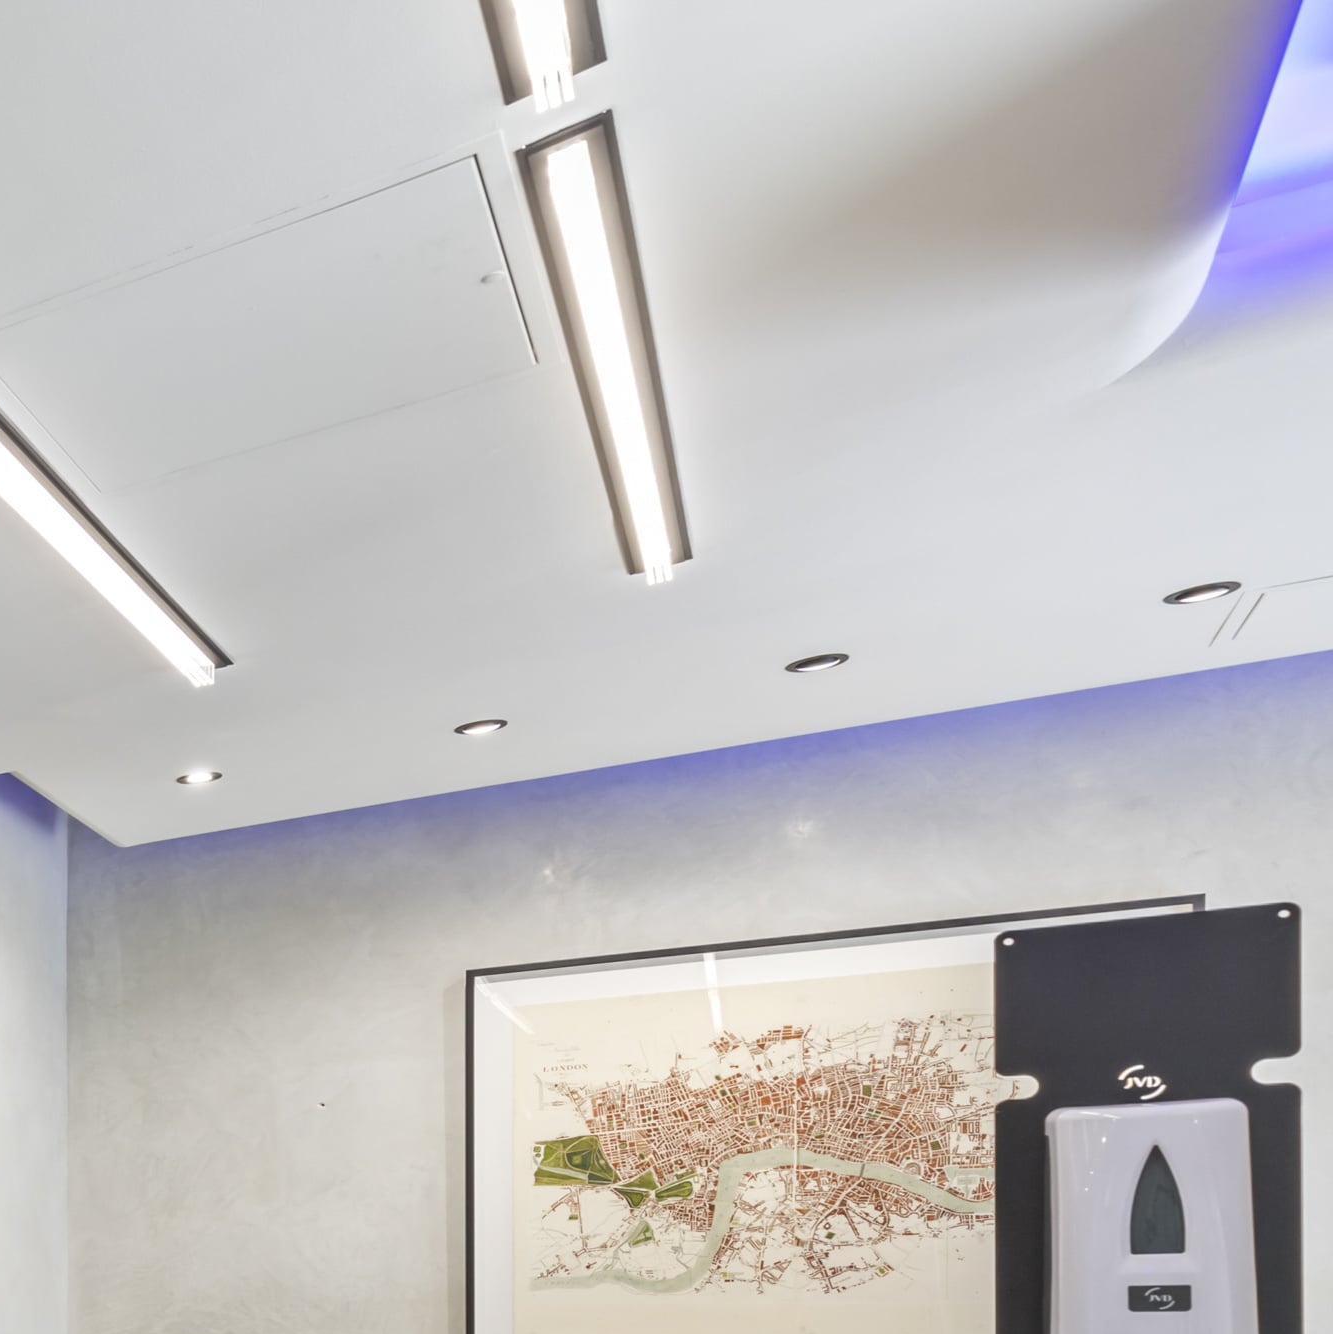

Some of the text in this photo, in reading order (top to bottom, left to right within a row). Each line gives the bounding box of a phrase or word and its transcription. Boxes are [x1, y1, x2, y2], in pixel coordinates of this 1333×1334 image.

[542, 1064, 588, 1073] LONDON
[1123, 1076, 1162, 1089] JVD
[1149, 1294, 1173, 1302] JVD
